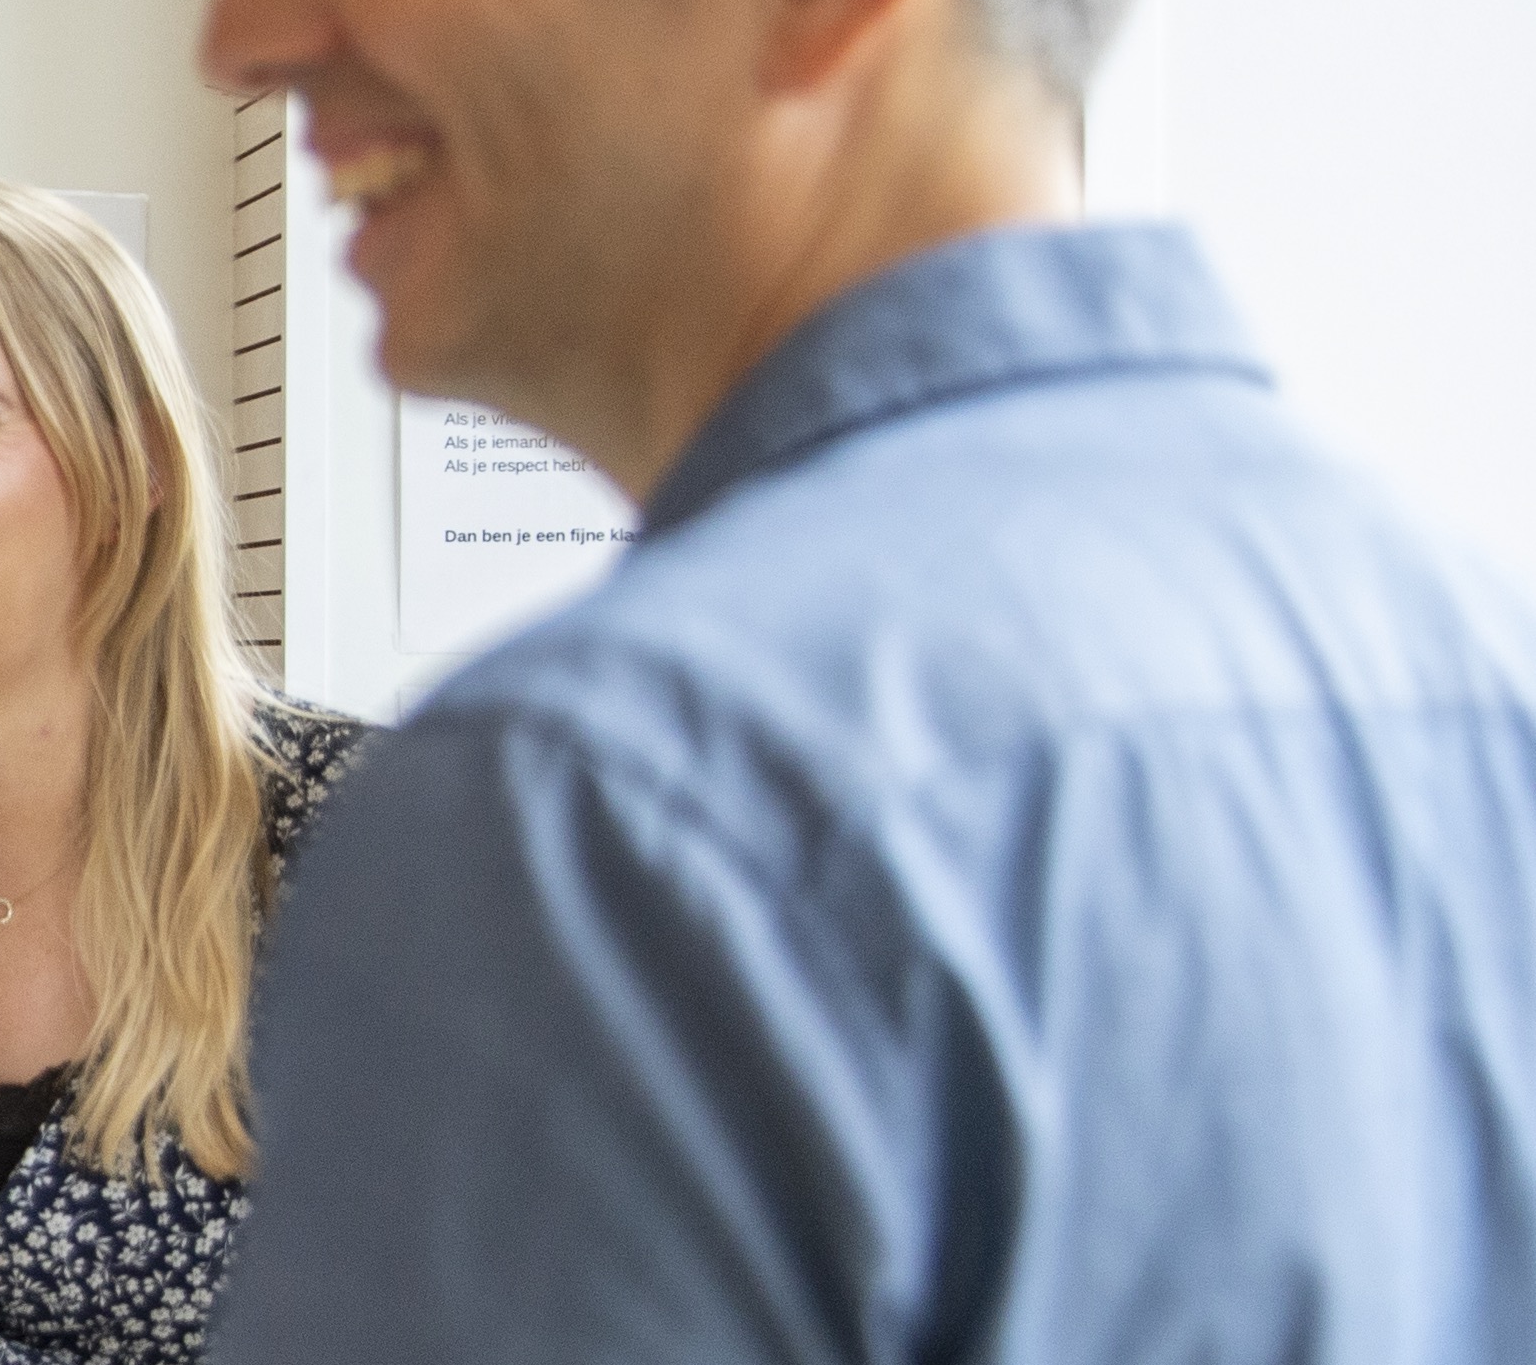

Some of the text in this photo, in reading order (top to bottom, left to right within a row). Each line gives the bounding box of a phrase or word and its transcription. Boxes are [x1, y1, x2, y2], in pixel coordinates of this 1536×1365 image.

[443, 412, 469, 426] Als
[472, 411, 487, 429] je
[444, 435, 469, 449] Als
[472, 438, 487, 452] je
[491, 434, 549, 449] iemand
[444, 459, 469, 473] Als
[472, 461, 487, 476] je
[491, 460, 548, 474] respect
[444, 529, 477, 543] Dan
[481, 529, 512, 543] ben
[515, 529, 531, 546] je
[535, 531, 566, 542] een
[569, 528, 605, 545] fijne
